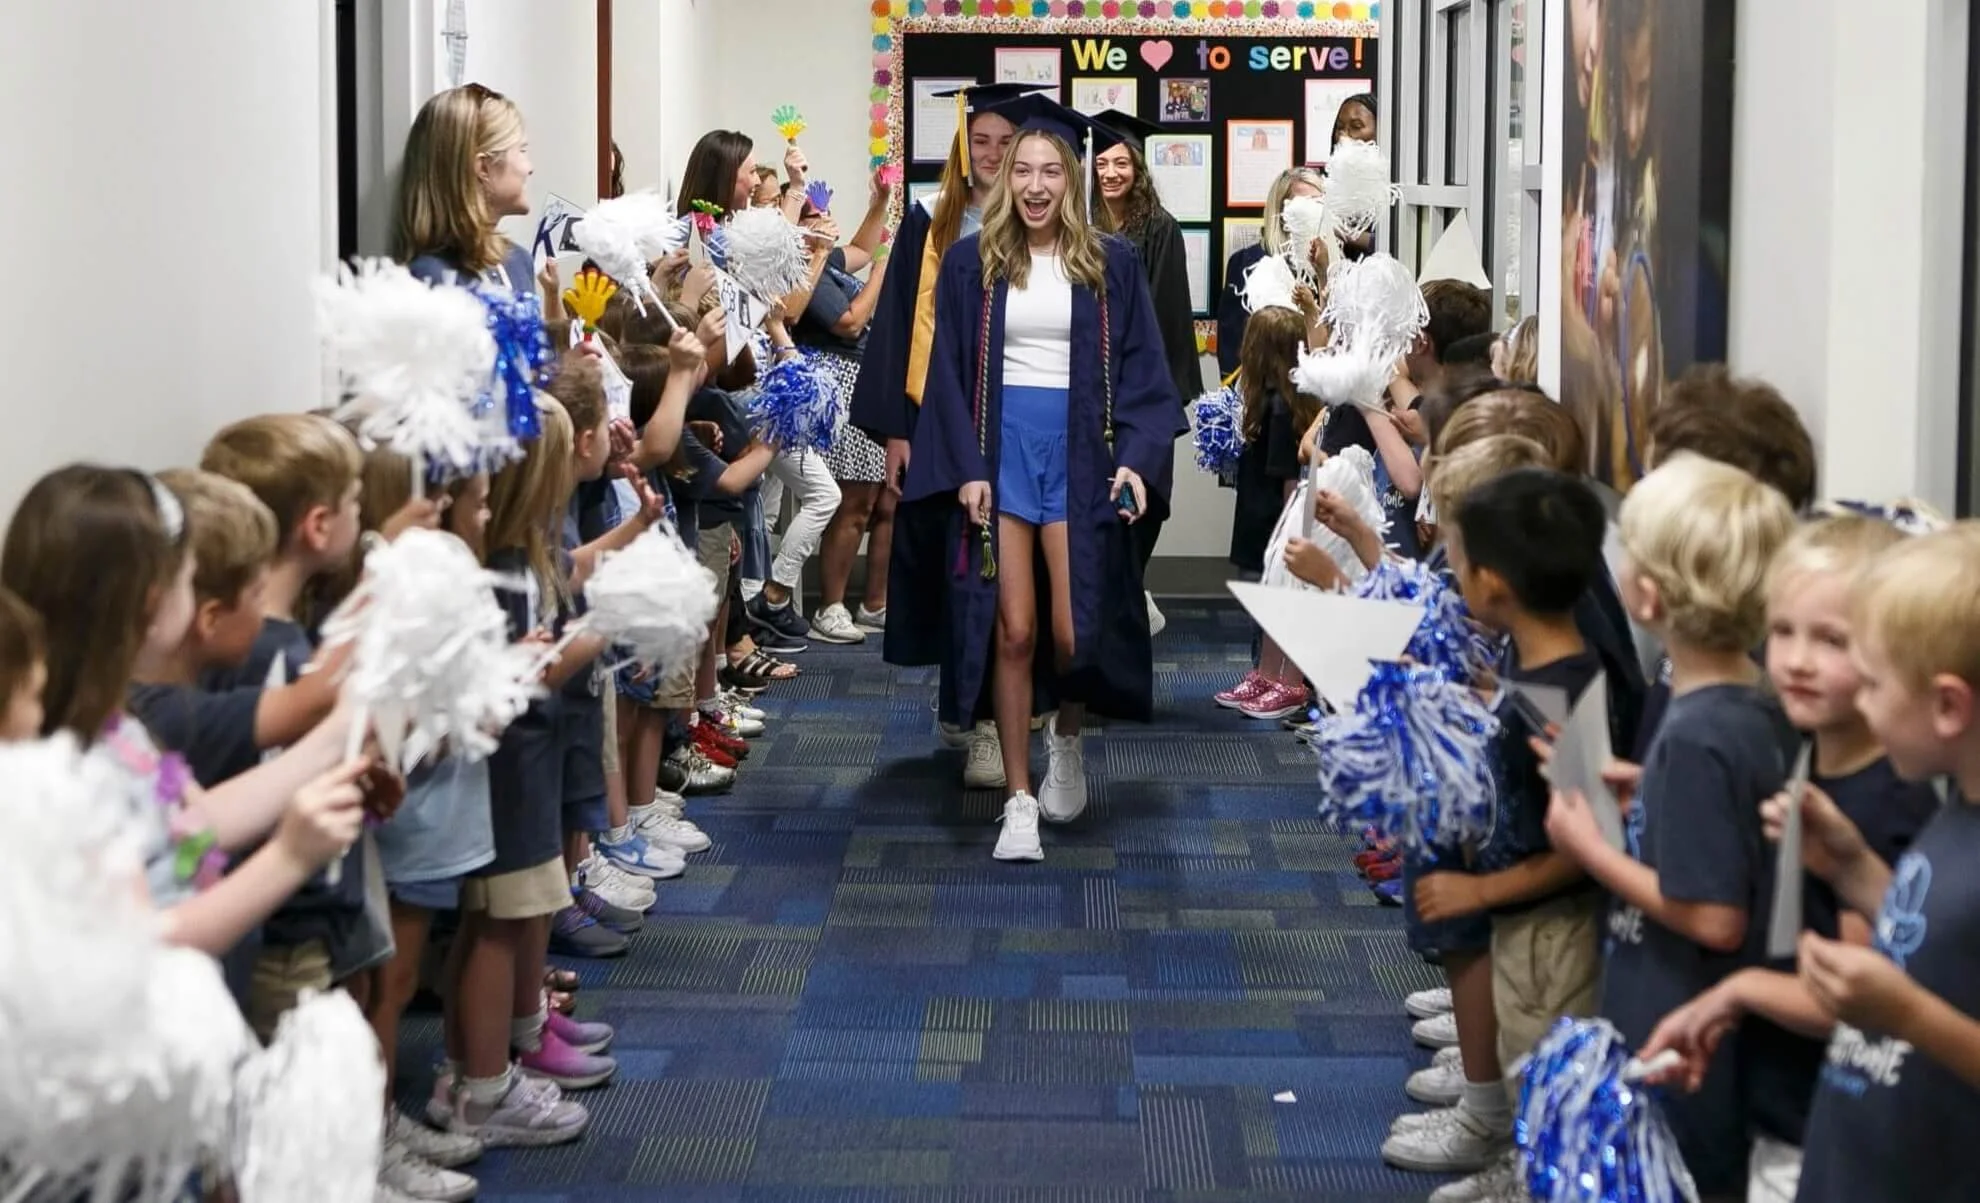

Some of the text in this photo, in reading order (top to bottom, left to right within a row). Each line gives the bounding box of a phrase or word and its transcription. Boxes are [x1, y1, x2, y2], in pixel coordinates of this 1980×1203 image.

[1072, 37, 1363, 71] We to serve!
